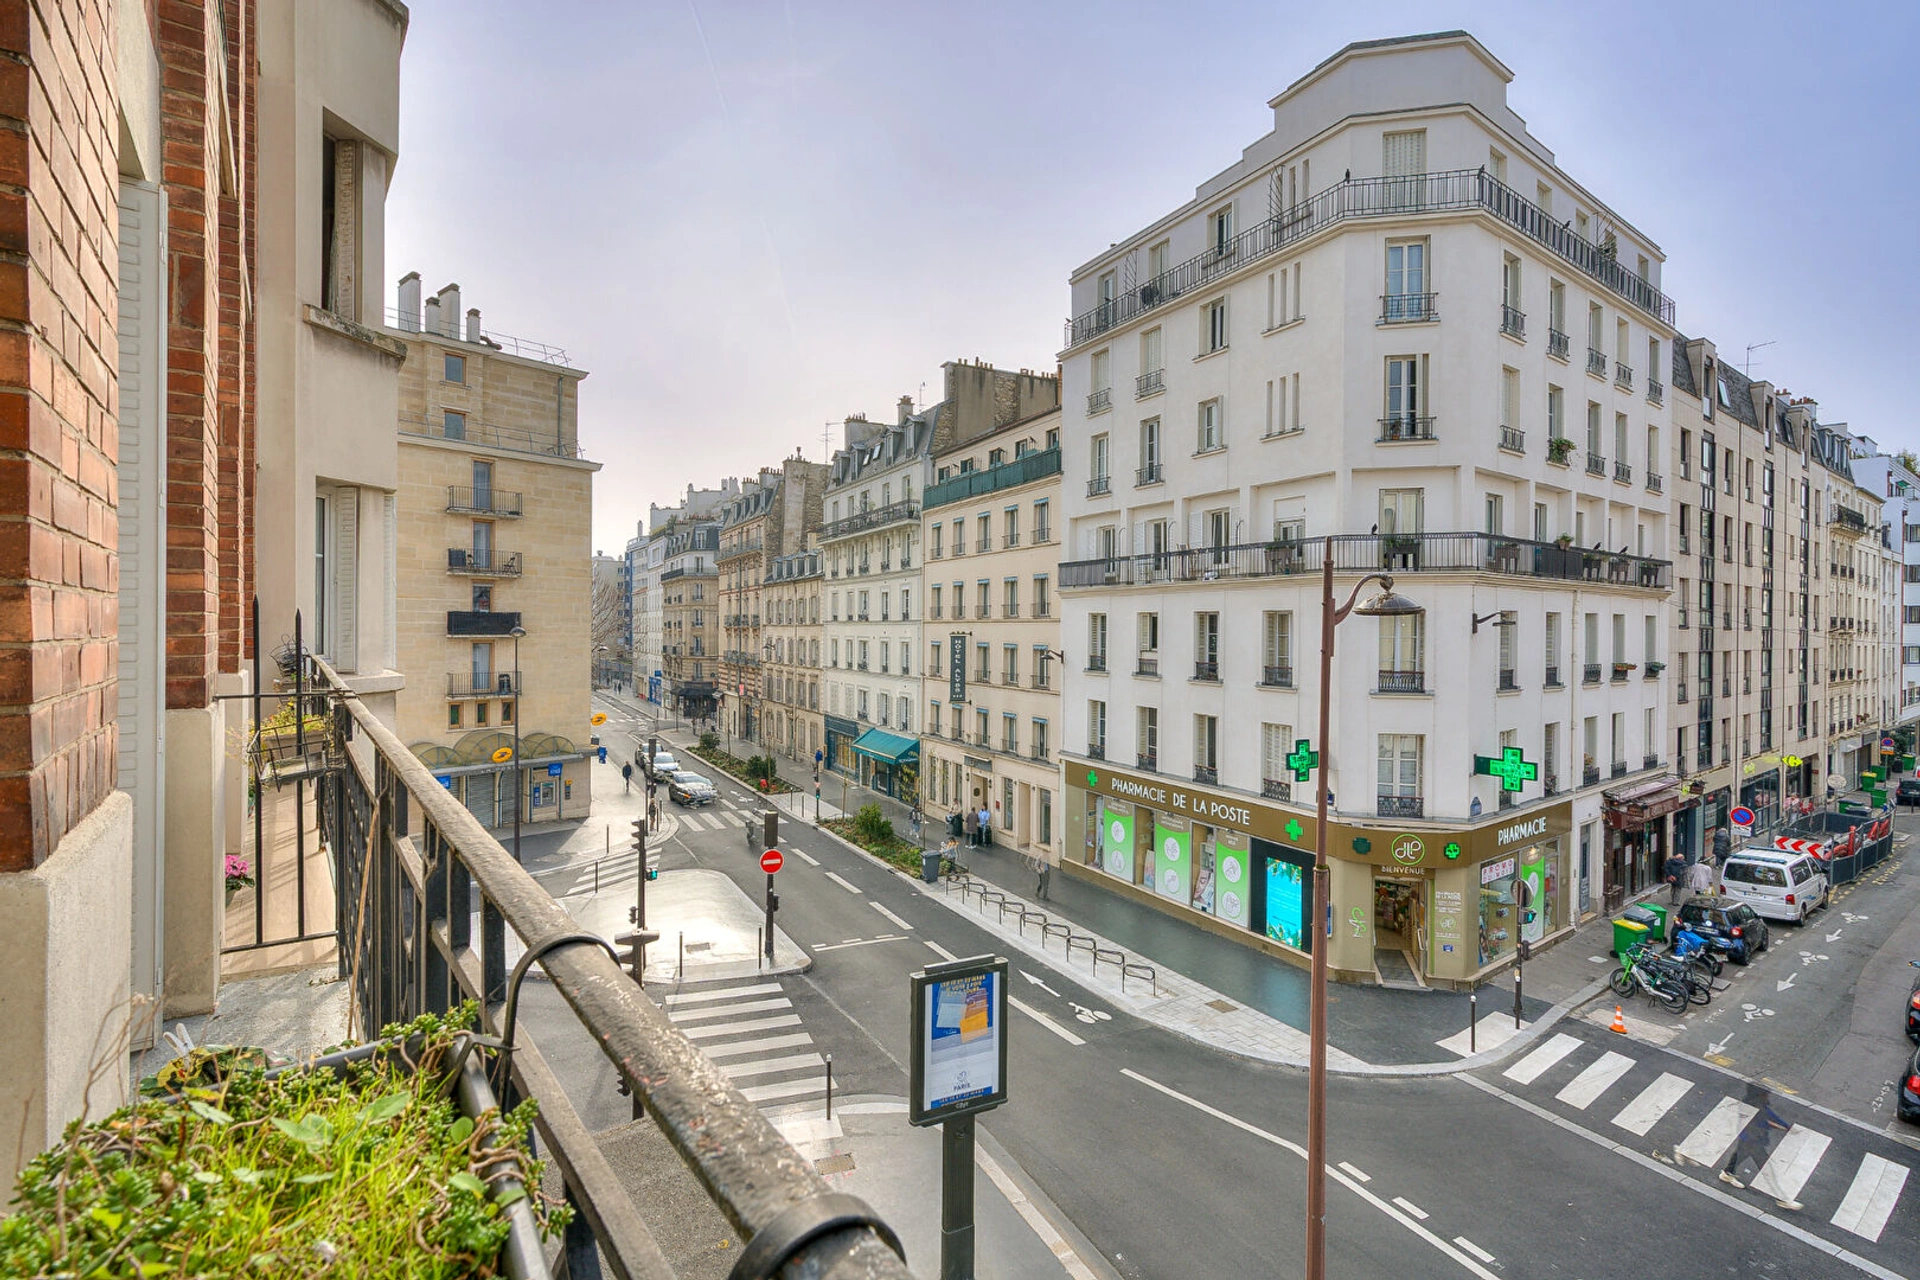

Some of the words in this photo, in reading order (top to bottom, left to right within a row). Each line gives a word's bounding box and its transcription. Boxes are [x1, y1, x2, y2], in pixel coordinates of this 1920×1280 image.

[1111, 777, 1167, 804] PHARMACIE
[1173, 792, 1187, 809] DE
[1193, 798, 1208, 815] LA
[1211, 802, 1251, 826] POSTE
[1497, 816, 1547, 846] PHARMACIE
[1381, 865, 1426, 876] BIENVENUE
